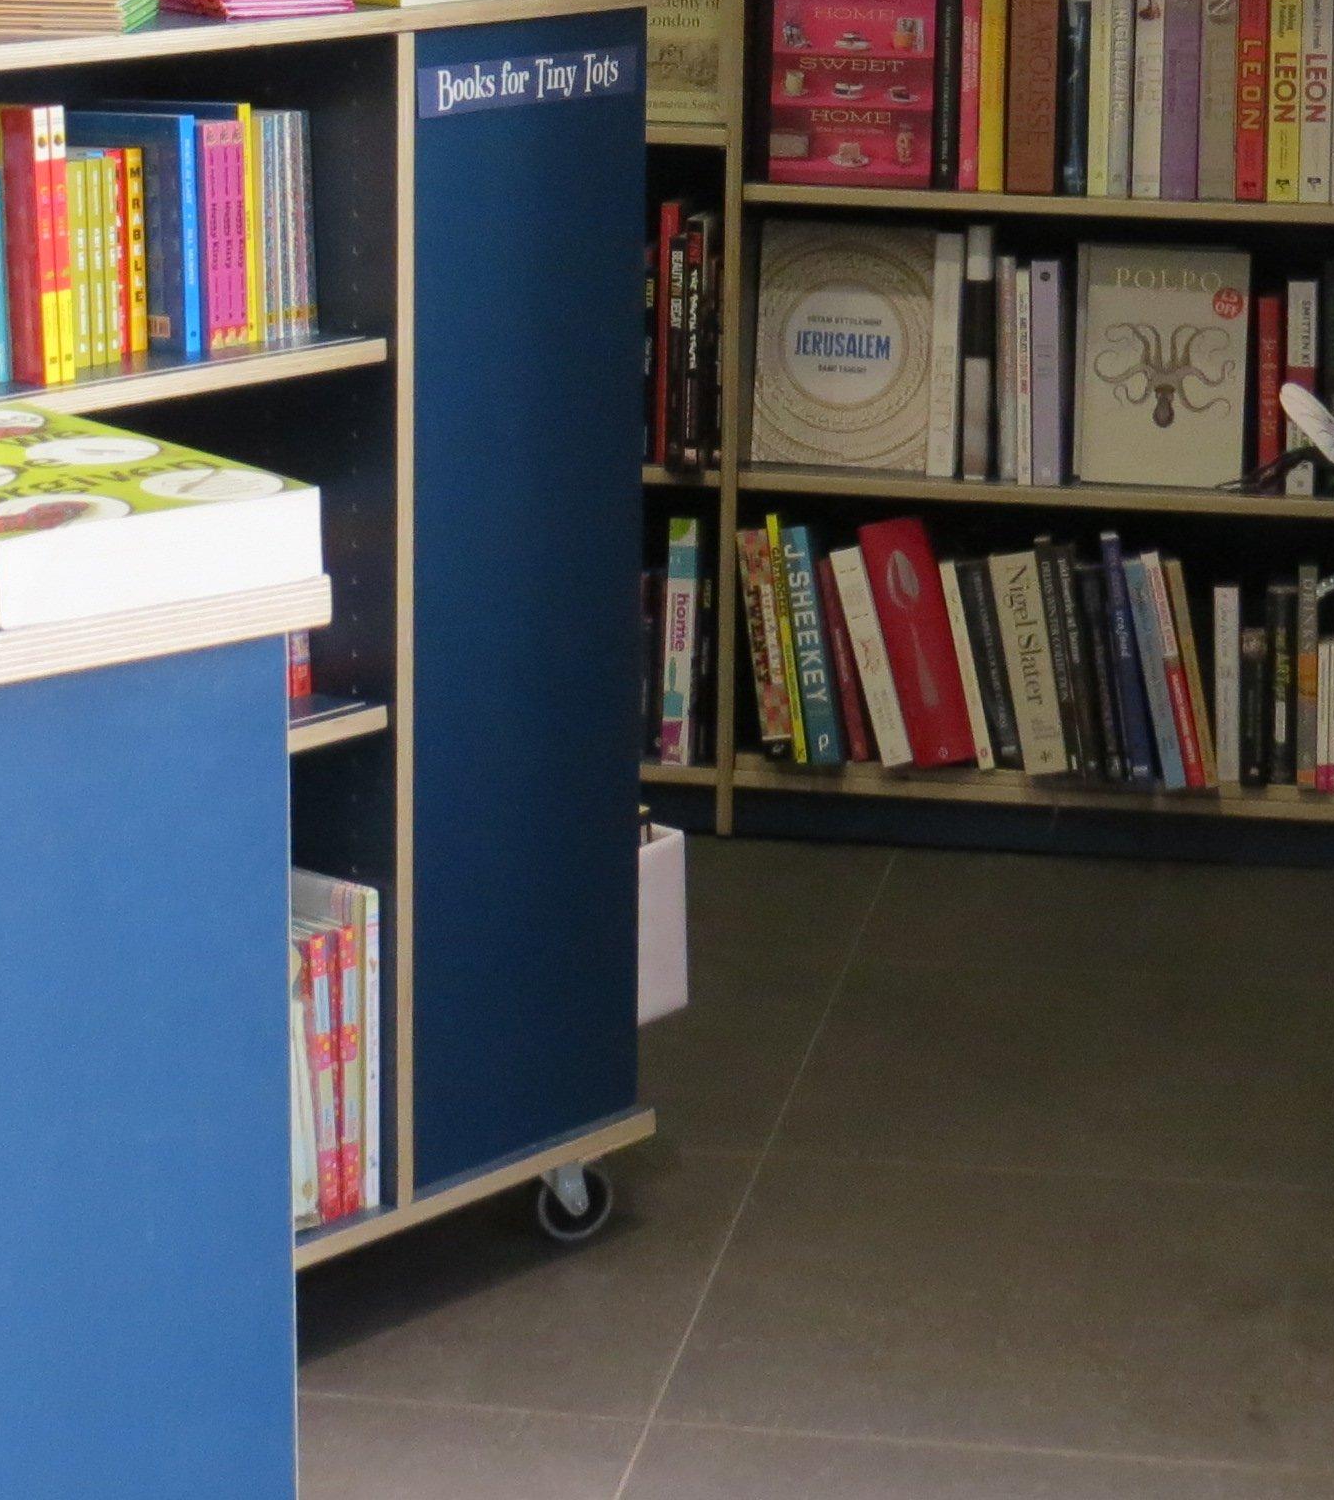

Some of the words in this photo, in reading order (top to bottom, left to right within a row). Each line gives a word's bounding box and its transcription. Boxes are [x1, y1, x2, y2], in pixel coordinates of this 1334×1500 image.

[812, 7, 895, 22] HOME
[437, 65, 495, 112] Books
[500, 60, 530, 95] for
[535, 56, 578, 99] Tiny
[584, 52, 620, 93] Tots
[798, 57, 905, 74] SWEET
[1026, 0, 1053, 149] LAROUSSE
[1240, 38, 1264, 130] LEON
[1273, 51, 1298, 124] LEON
[1304, 52, 1329, 124] LEON
[809, 109, 893, 126] HOME
[669, 250, 684, 287] BEAUTY
[1112, 265, 1224, 290] POLPO
[794, 331, 891, 362] JERUSALEM
[673, 591, 691, 652] home
[782, 543, 826, 704] J.SHEEKEY
[1005, 562, 1035, 632] Nigel
[1013, 633, 1043, 706] Slater
